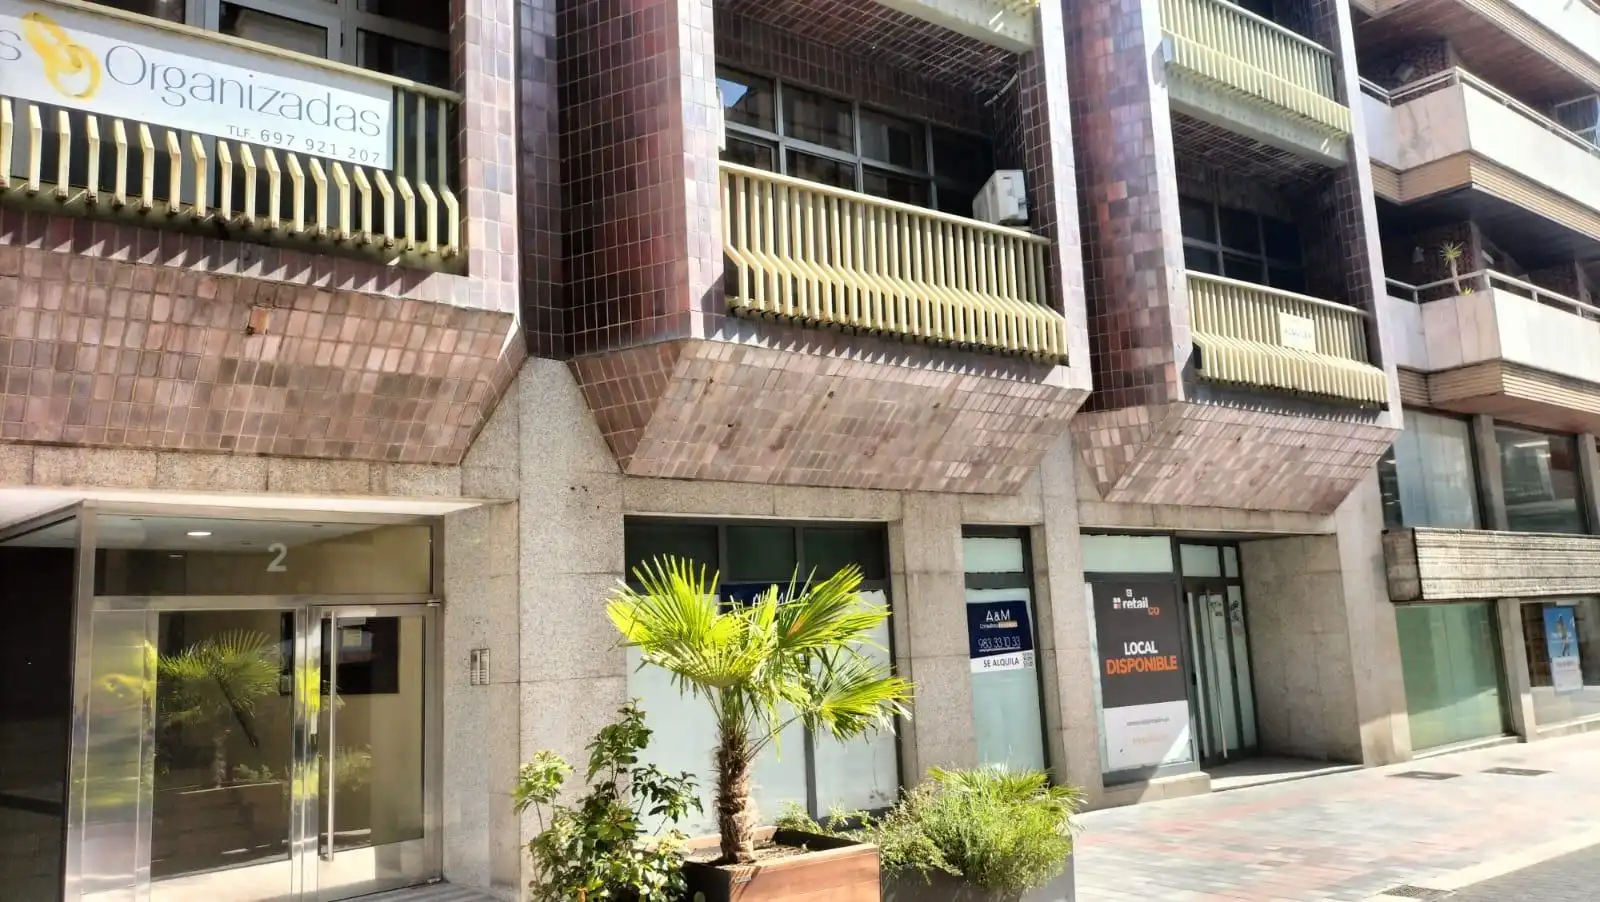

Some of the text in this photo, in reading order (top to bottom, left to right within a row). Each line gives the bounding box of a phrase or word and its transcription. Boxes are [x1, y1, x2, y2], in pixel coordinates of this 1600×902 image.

[105, 45, 381, 138] Organizadas
[260, 129, 295, 146] 697
[305, 138, 337, 155] 921
[347, 147, 380, 163] 207
[267, 543, 287, 572] 2
[1123, 597, 1148, 609] retail
[986, 609, 1010, 622] A&M
[1124, 641, 1158, 655] LOCAL
[983, 657, 1020, 668] SE ALQUILA
[1107, 656, 1178, 675] DISPONIBLE
